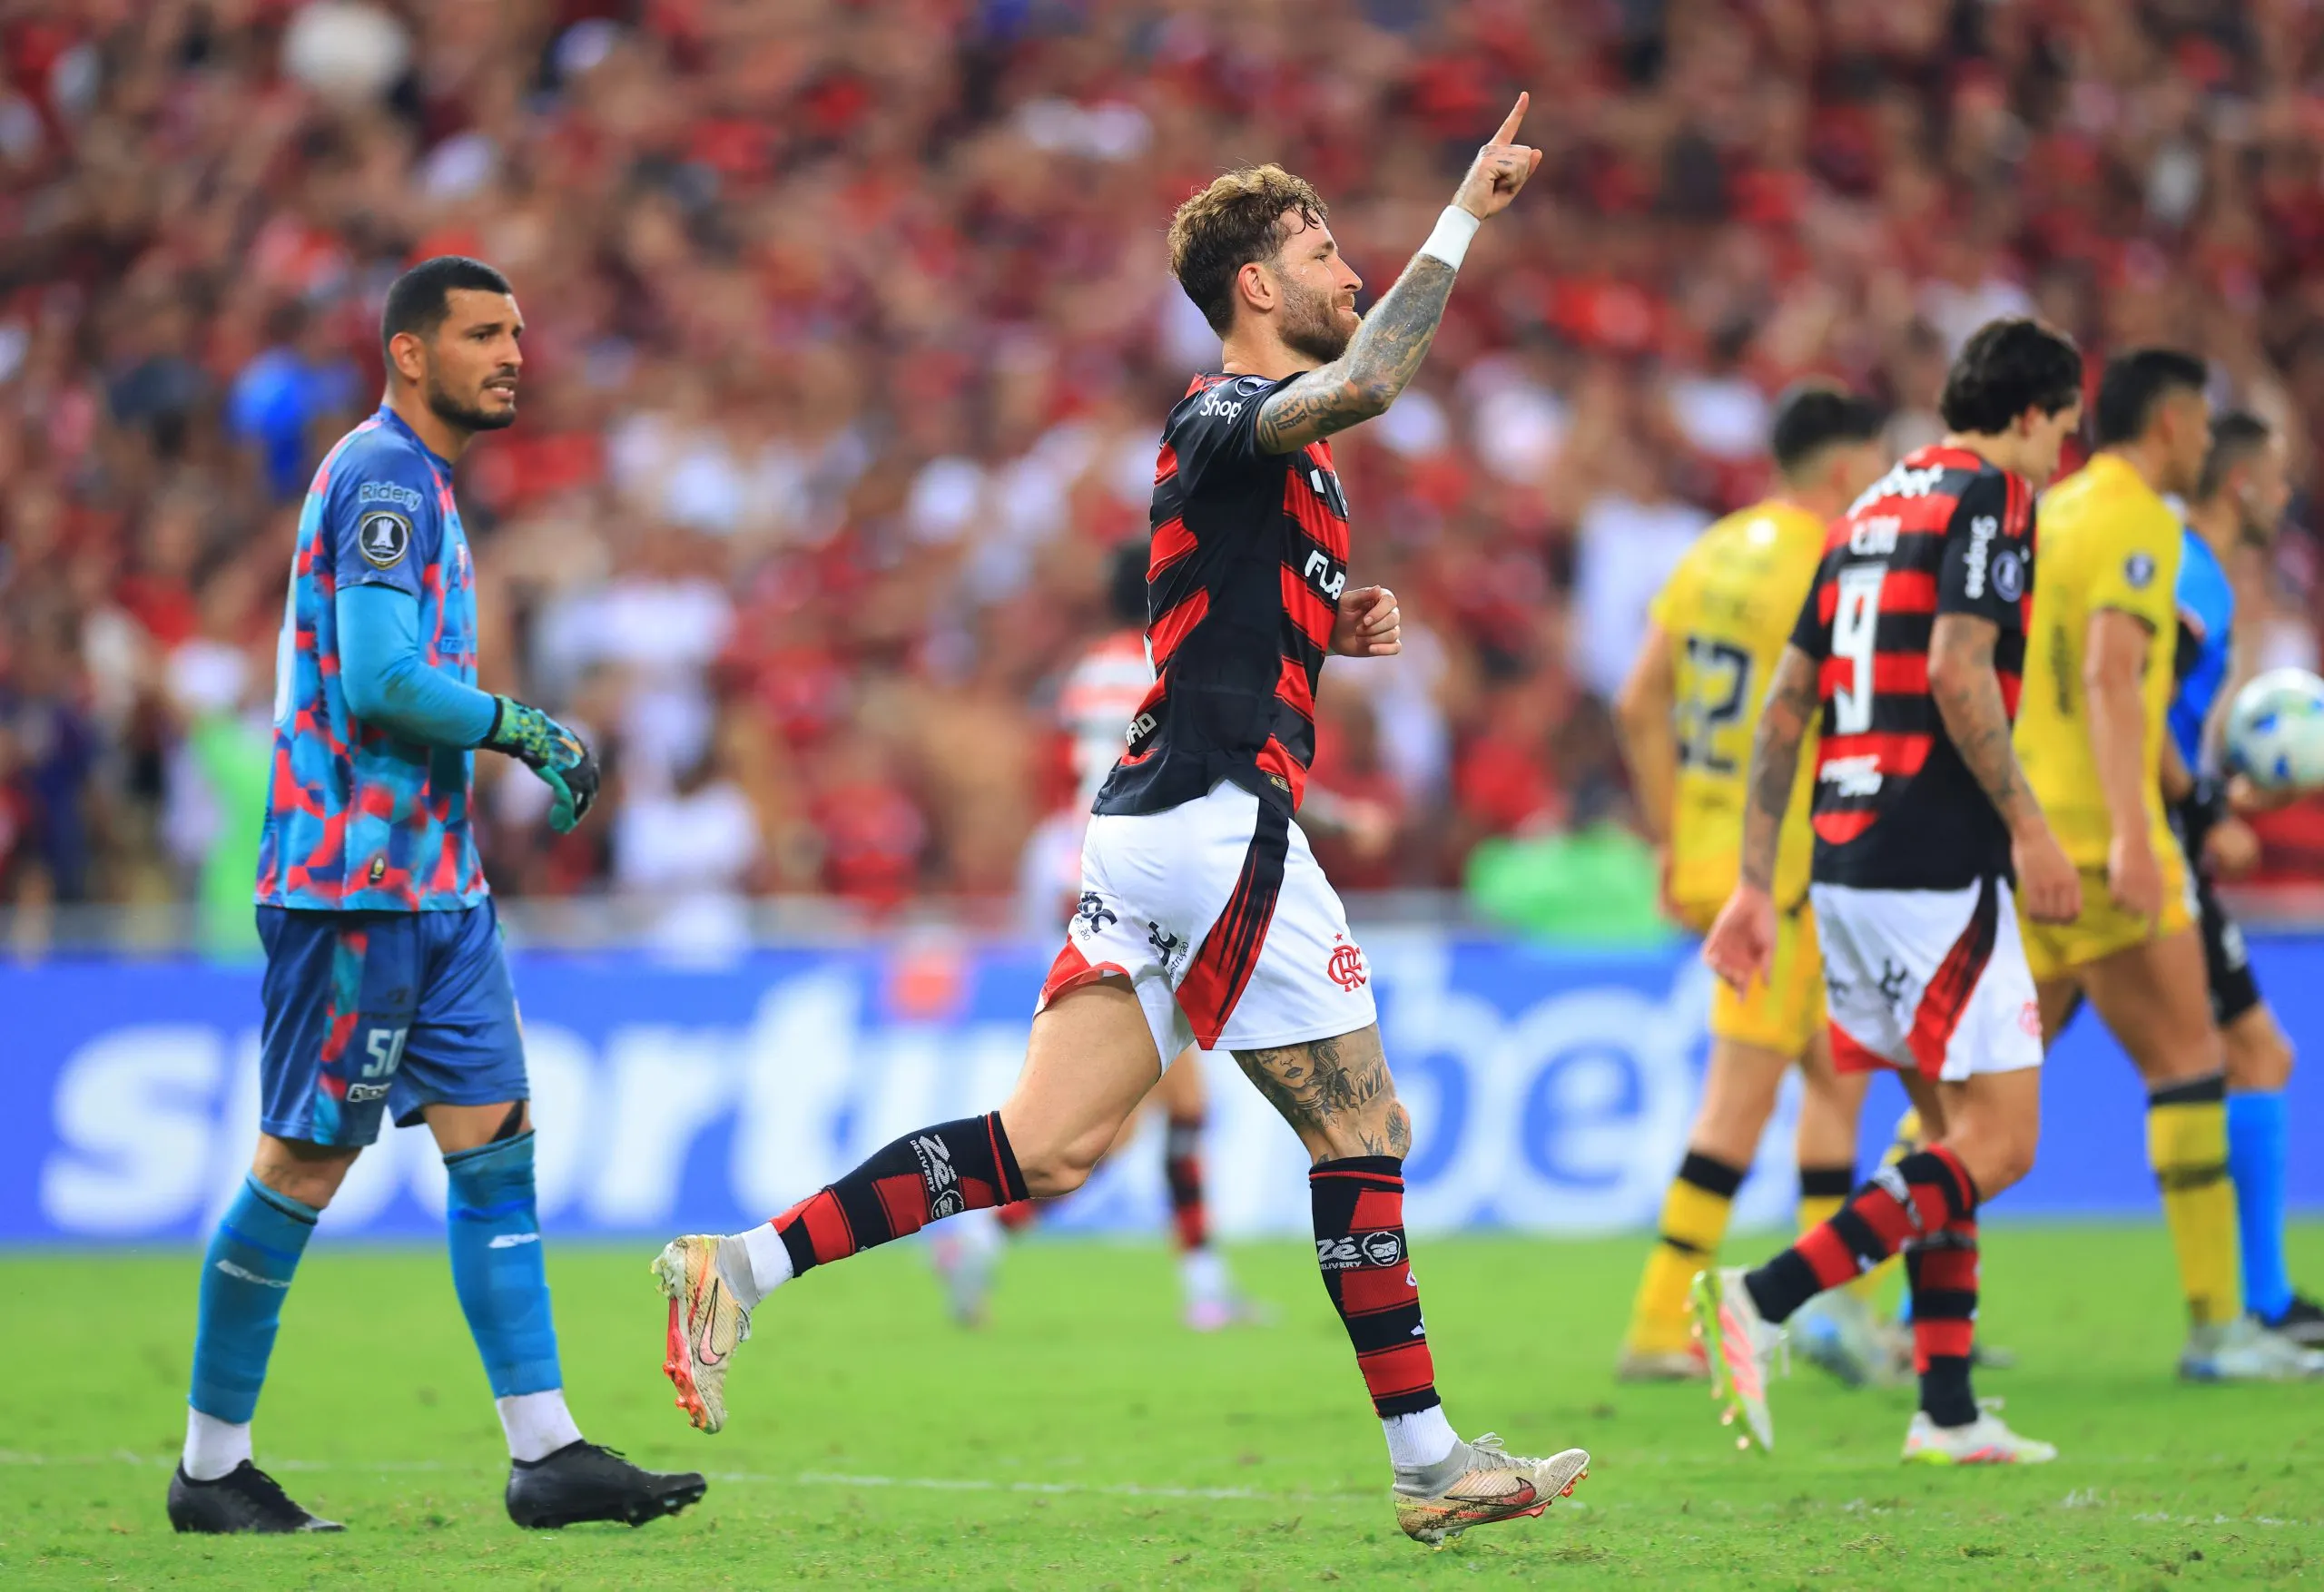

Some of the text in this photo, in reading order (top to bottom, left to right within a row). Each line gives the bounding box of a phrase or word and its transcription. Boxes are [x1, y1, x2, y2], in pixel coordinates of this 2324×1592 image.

[359, 481, 423, 512] Ridery
[1831, 560, 1889, 734] 9
[361, 1027, 409, 1077] 50
[909, 1139, 936, 1193] DELIVERY
[1316, 1235, 1363, 1263] Zé
